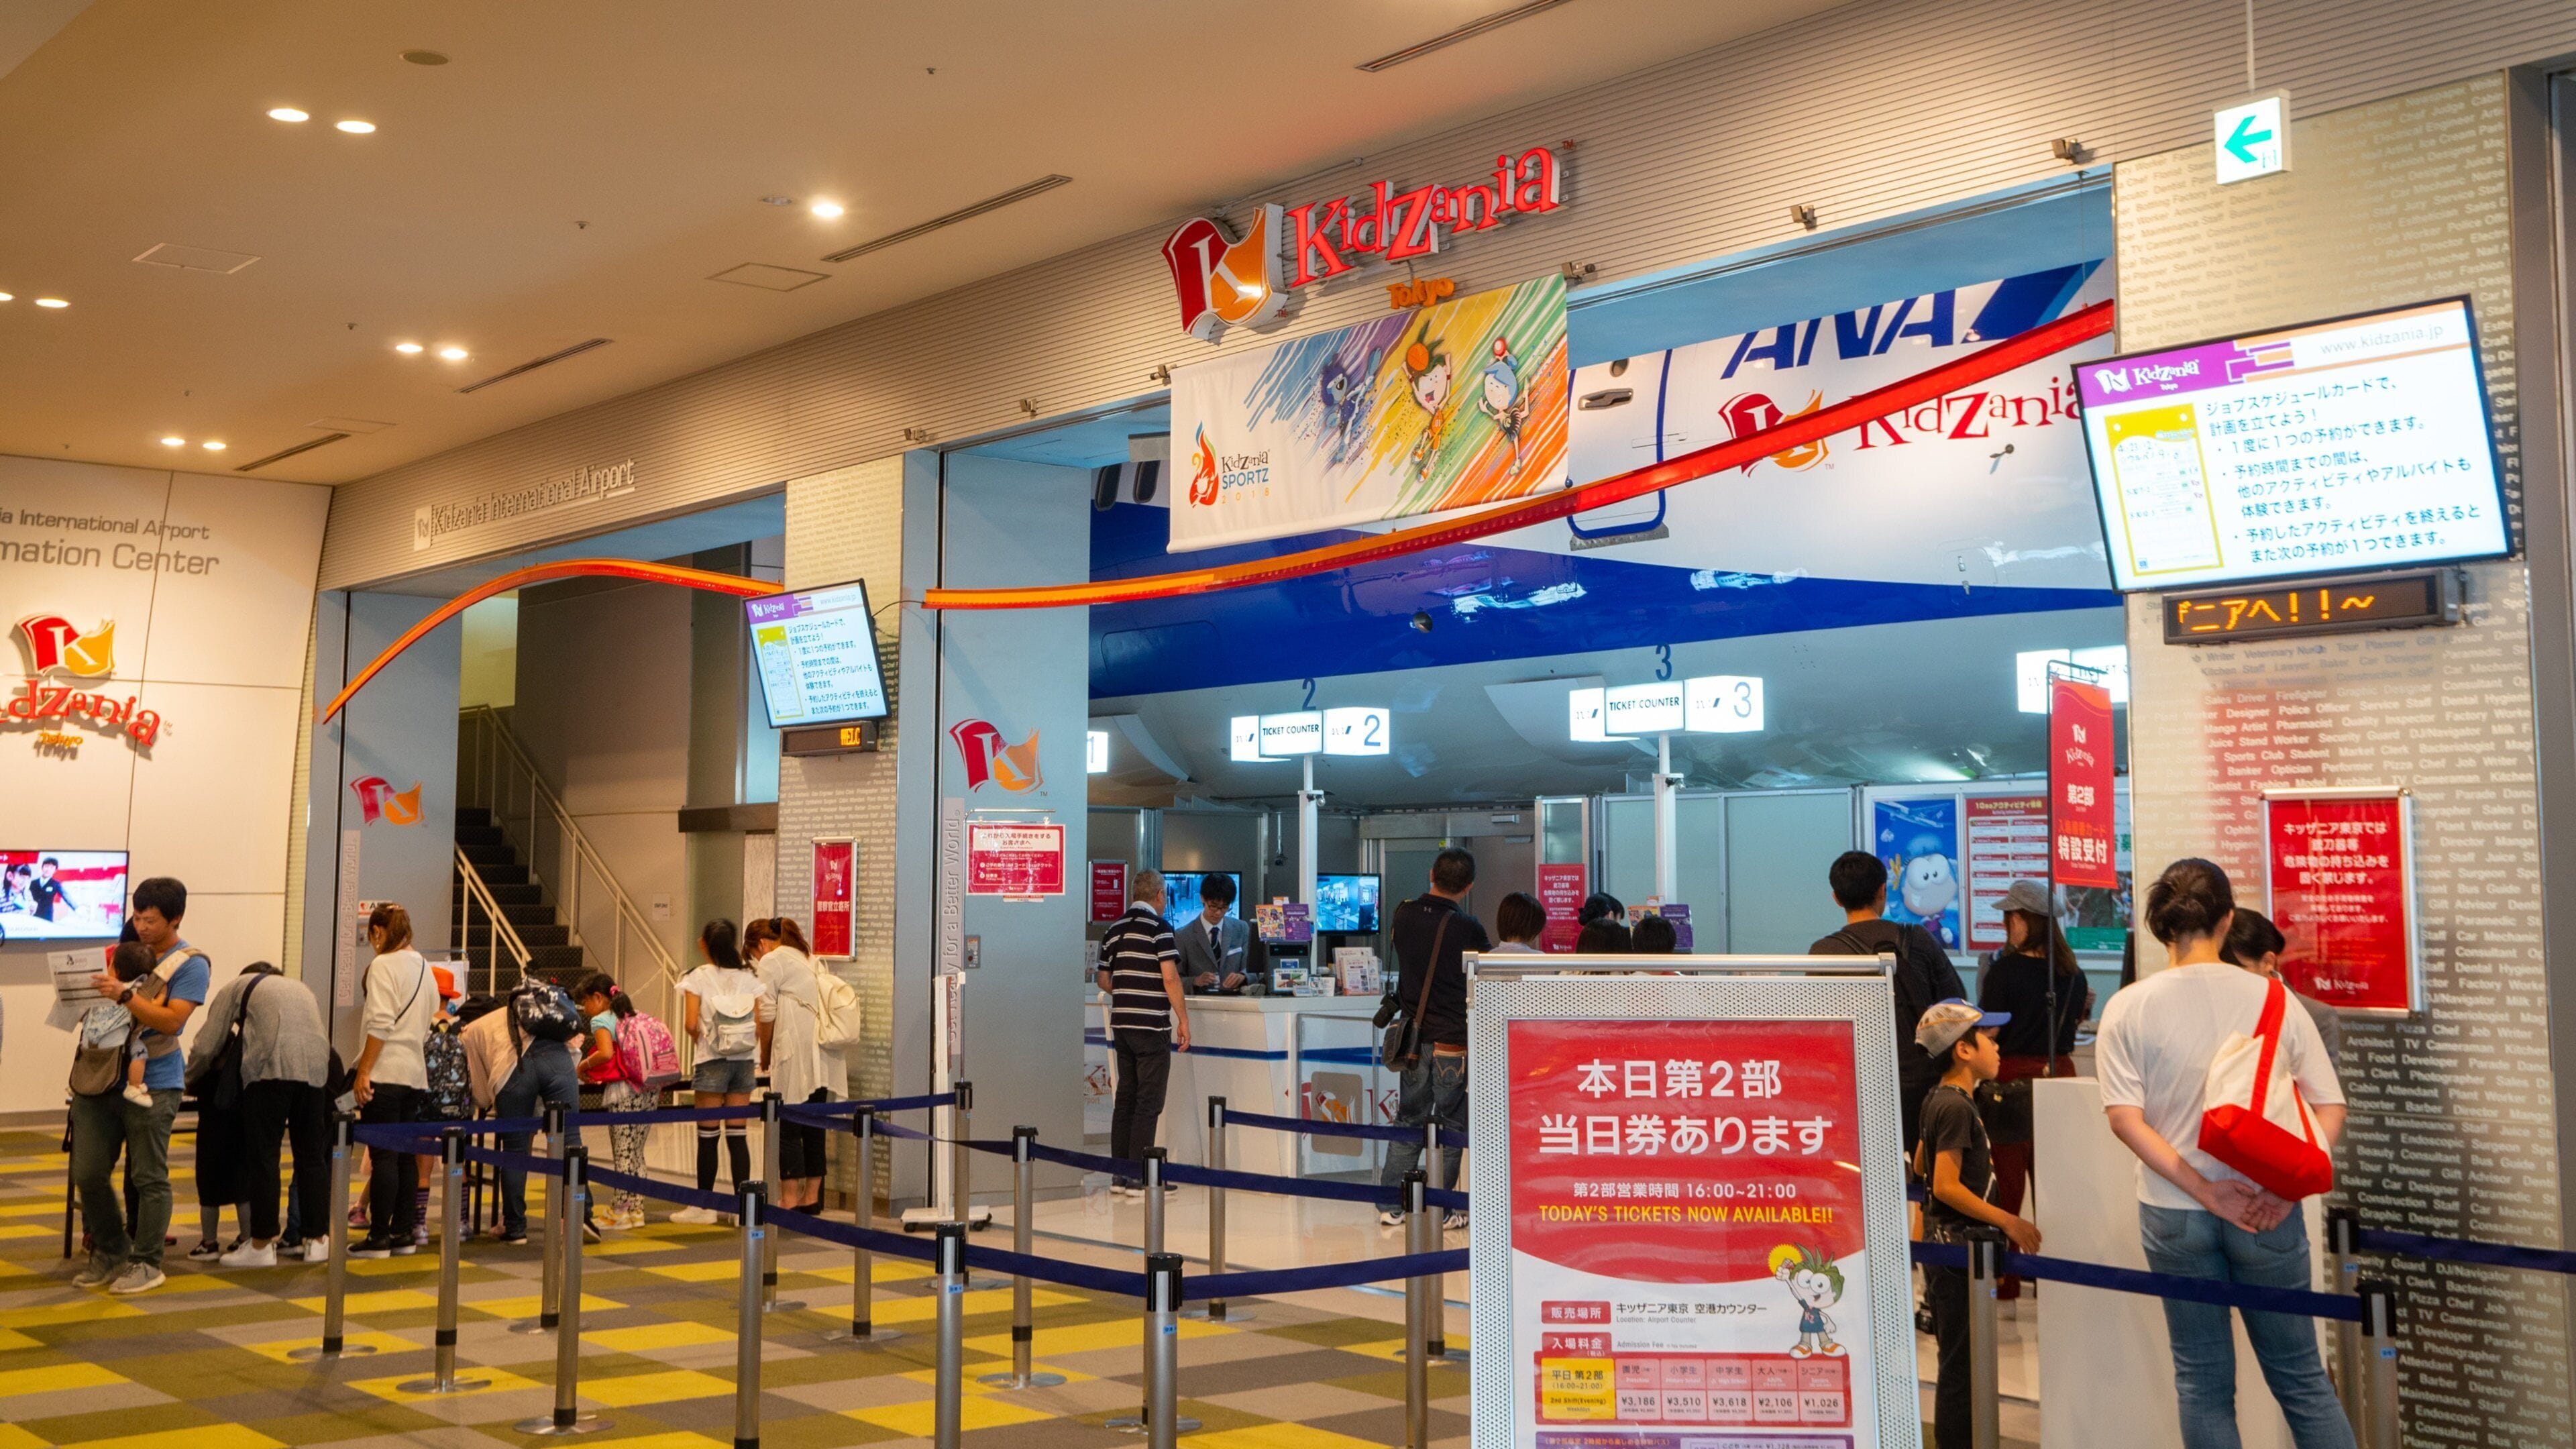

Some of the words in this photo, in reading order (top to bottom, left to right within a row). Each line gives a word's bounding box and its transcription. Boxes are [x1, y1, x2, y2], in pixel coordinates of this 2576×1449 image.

[1386, 276, 1456, 310] Tokyo
[2320, 325, 2444, 356] www.kidzania.jp
[1222, 468, 1269, 490] SPORTZ
[490, 470, 576, 521] International
[579, 458, 635, 499] Airport
[1222, 487, 1270, 504] 2018
[20, 508, 139, 535] International
[143, 519, 210, 541] Airport
[112, 542, 220, 576] Center
[1655, 643, 1672, 681] 3
[1302, 678, 1316, 710] 2
[1733, 682, 1752, 718] 3
[1609, 700, 1635, 711] TICKET
[1639, 696, 1680, 708] COUNTER
[2226, 708, 2270, 720] Designer
[2278, 704, 2311, 716] Police
[1263, 727, 1284, 736] TICKET
[1286, 724, 1320, 735] COUNTER
[1364, 714, 1381, 746] 2
[2204, 724, 2237, 735] Manga
[2241, 721, 2268, 733] Artist
[2275, 718, 2333, 731] Pharmacist
[2208, 738, 2235, 749] Juice
[2239, 736, 2268, 747] Stand
[2272, 734, 2310, 745] Worker
[2224, 751, 2256, 764] Sports
[2260, 749, 2285, 761] Club
[2289, 748, 2330, 759] Student
[2226, 765, 2263, 777] Banker
[2270, 763, 2314, 776] Optician
[2068, 784, 2094, 806] 第2部
[2284, 822, 2387, 836] キッザニア東京では
[2057, 835, 2108, 864] 特設受付
[944, 870, 959, 915] Better
[947, 922, 959, 931] a
[943, 937, 959, 957] for
[2347, 1036, 2394, 1049] Architect
[2405, 1038, 2420, 1051] TV
[2367, 1052, 2397, 1065] Food
[2401, 1053, 2459, 1069] Developer
[1577, 1058, 1782, 1099] 本日第2部
[2408, 1069, 2485, 1086] Photographer
[2347, 1082, 2380, 1095] Cabin
[2385, 1083, 2440, 1099] Attendant
[2449, 1088, 2479, 1101] Plant
[2383, 1117, 2455, 1132] Maintenance
[2461, 1121, 2489, 1134] Staff
[1538, 1114, 1833, 1156] 当日券あります
[2400, 1132, 2465, 1149] Endoscopic
[2356, 1144, 2395, 1160] Beauty
[2400, 1148, 2461, 1165] Consultant
[2470, 1155, 2494, 1167] Bus
[2440, 1167, 2463, 1181] Gift
[1573, 1182, 1680, 1199] 第2部営業時間
[2408, 1179, 2459, 1196] Designer
[2469, 1186, 2532, 1203] Paramedic
[2357, 1191, 2428, 1209] Construction
[2432, 1198, 2461, 1212] Staff
[1539, 1205, 1608, 1224] TODAY'S
[1613, 1205, 1681, 1223] TICKETS
[1687, 1205, 1727, 1223] NOW
[1732, 1205, 1833, 1224] AVAILABLE!!
[2408, 1212, 2460, 1228] Designer
[2391, 1257, 2427, 1272] Guard
[2406, 1276, 2436, 1290] Clerk
[2408, 1291, 2440, 1307] Pizza
[2446, 1296, 2475, 1311] Chef
[1550, 1307, 1602, 1320] 販売場所
[1615, 1302, 1689, 1315] キッザニア東京
[1695, 1303, 1767, 1315] 空港カウンター
[1648, 1316, 1669, 1325] Airport
[1552, 1337, 1603, 1350] 入場料金
[1617, 1341, 1650, 1349] Admission
[1552, 1370, 1572, 1381] 平日
[1574, 1370, 1604, 1381] 第2部
[1670, 1364, 1698, 1375] 小学生
[1715, 1366, 1743, 1375] 中学生
[1757, 1366, 1775, 1375] 大人
[1801, 1366, 1824, 1376] シニア
[1621, 1397, 1656, 1407] ¥3,186
[1667, 1397, 1701, 1407] ¥3,510
[1713, 1397, 1747, 1407] ¥3,618
[1758, 1397, 1792, 1407] ¥2,106
[1804, 1397, 1839, 1407] ¥1,026
